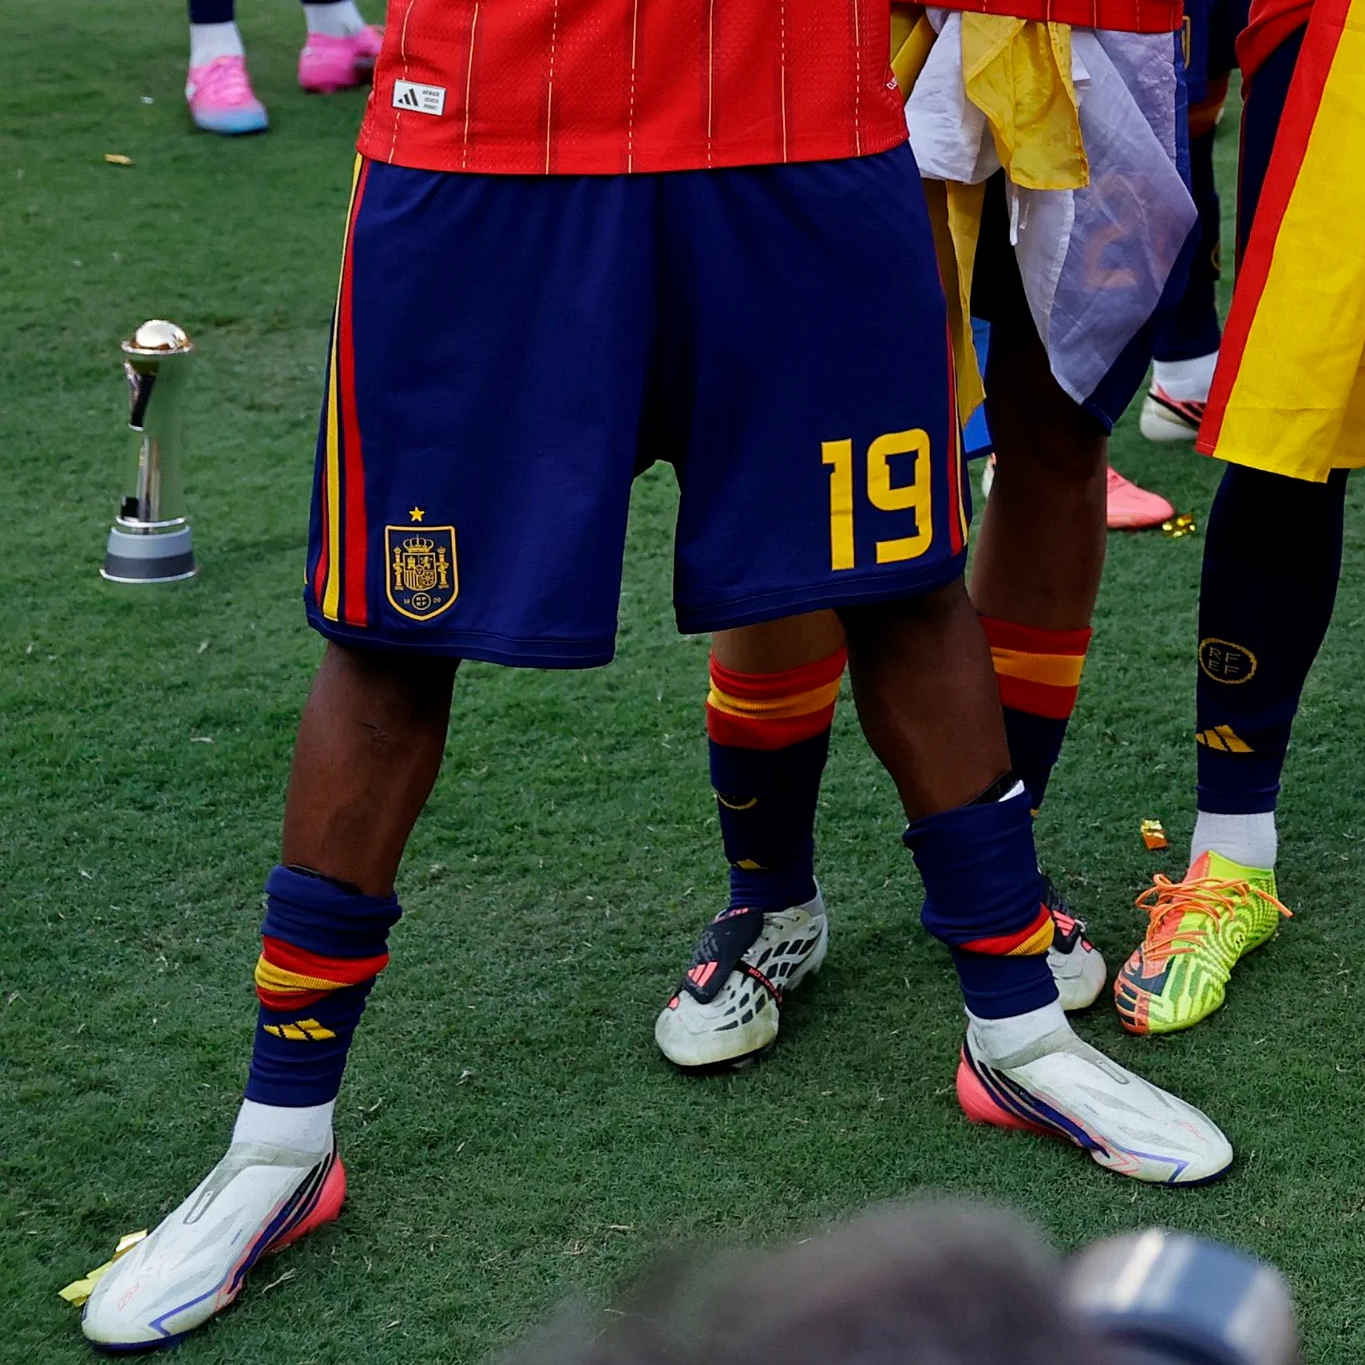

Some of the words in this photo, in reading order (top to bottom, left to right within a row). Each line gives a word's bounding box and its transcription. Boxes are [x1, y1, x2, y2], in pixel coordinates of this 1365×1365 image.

[821, 427, 933, 572] 19
[1209, 646, 1242, 663] RF
[1208, 658, 1240, 676] EF
